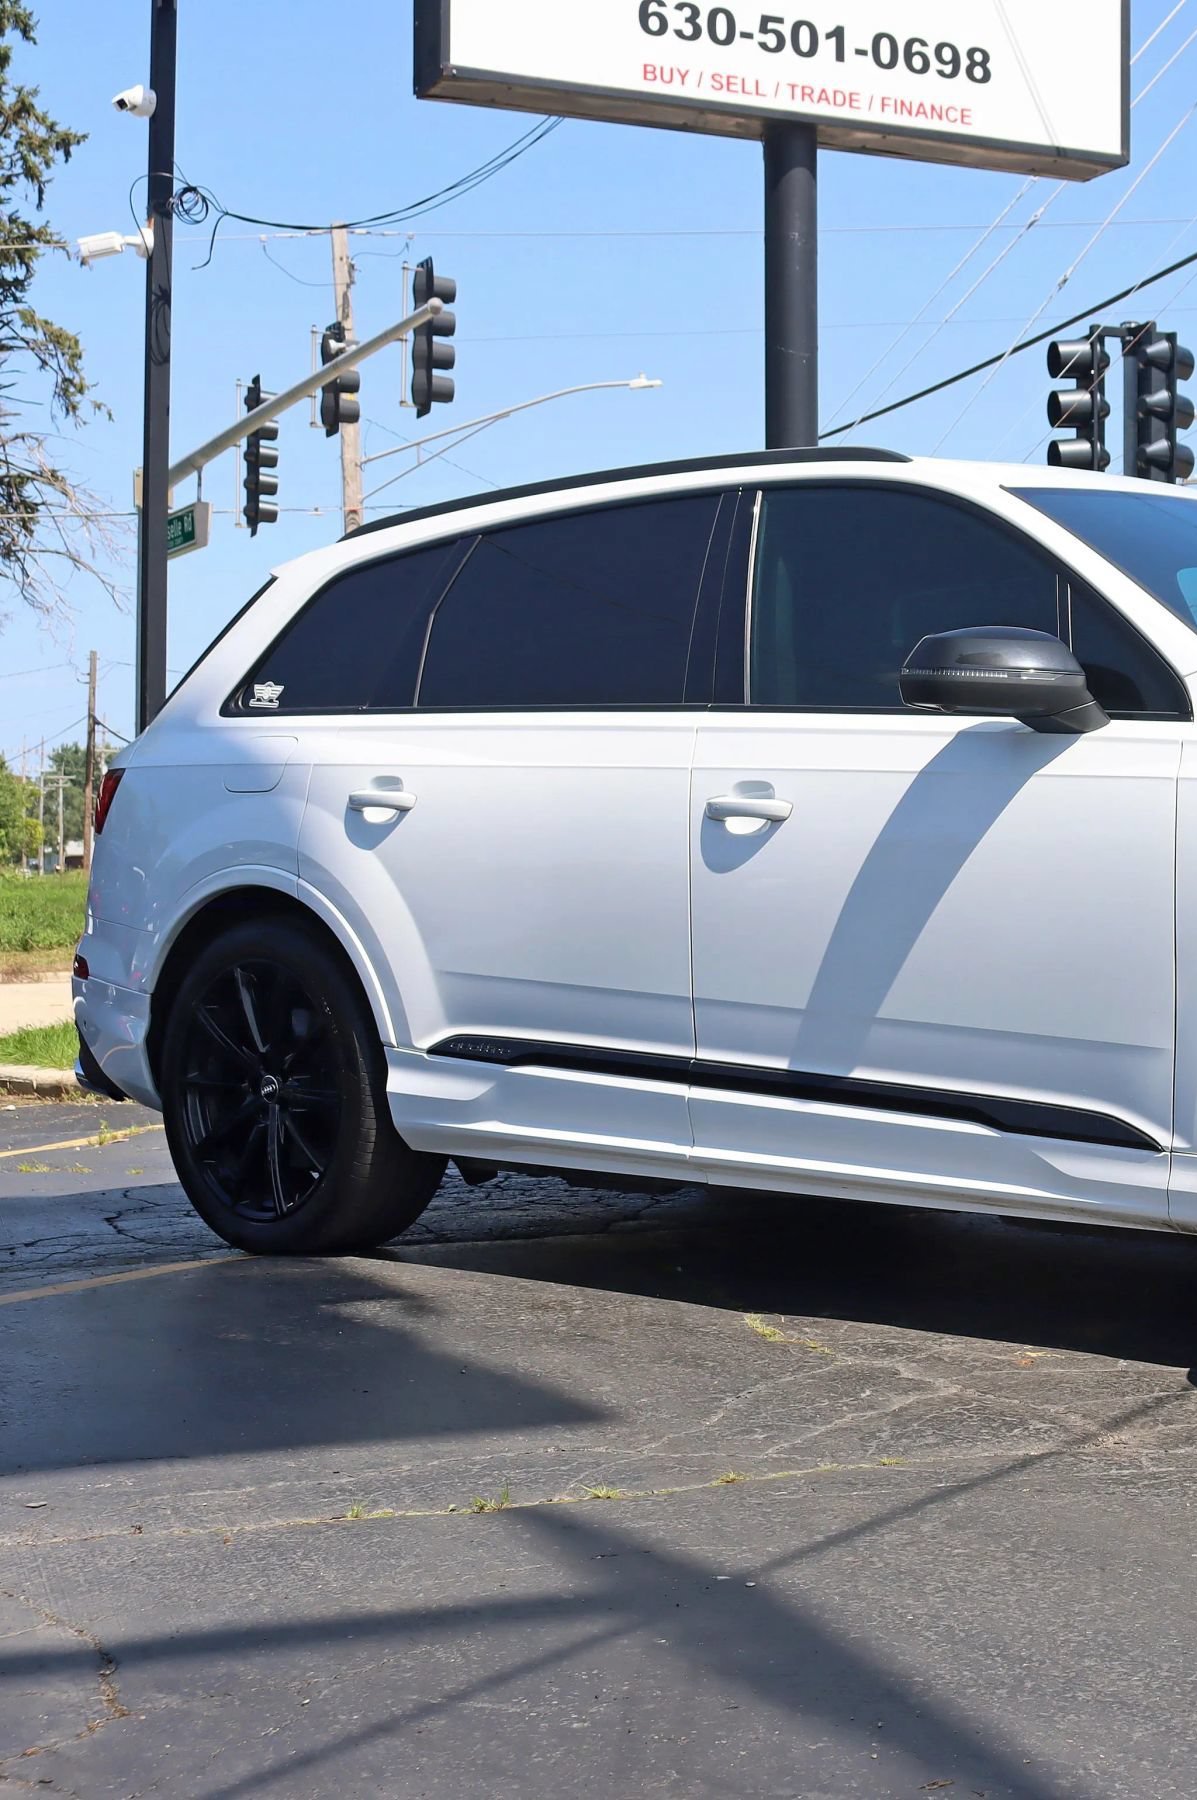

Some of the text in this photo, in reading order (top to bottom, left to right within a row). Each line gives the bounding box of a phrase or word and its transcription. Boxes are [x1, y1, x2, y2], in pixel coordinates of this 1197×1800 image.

[638, 0, 992, 84] 630-501-0698
[642, 63, 973, 125] BUY / SELL / TRADE / FINANCE
[167, 519, 182, 540] selle
